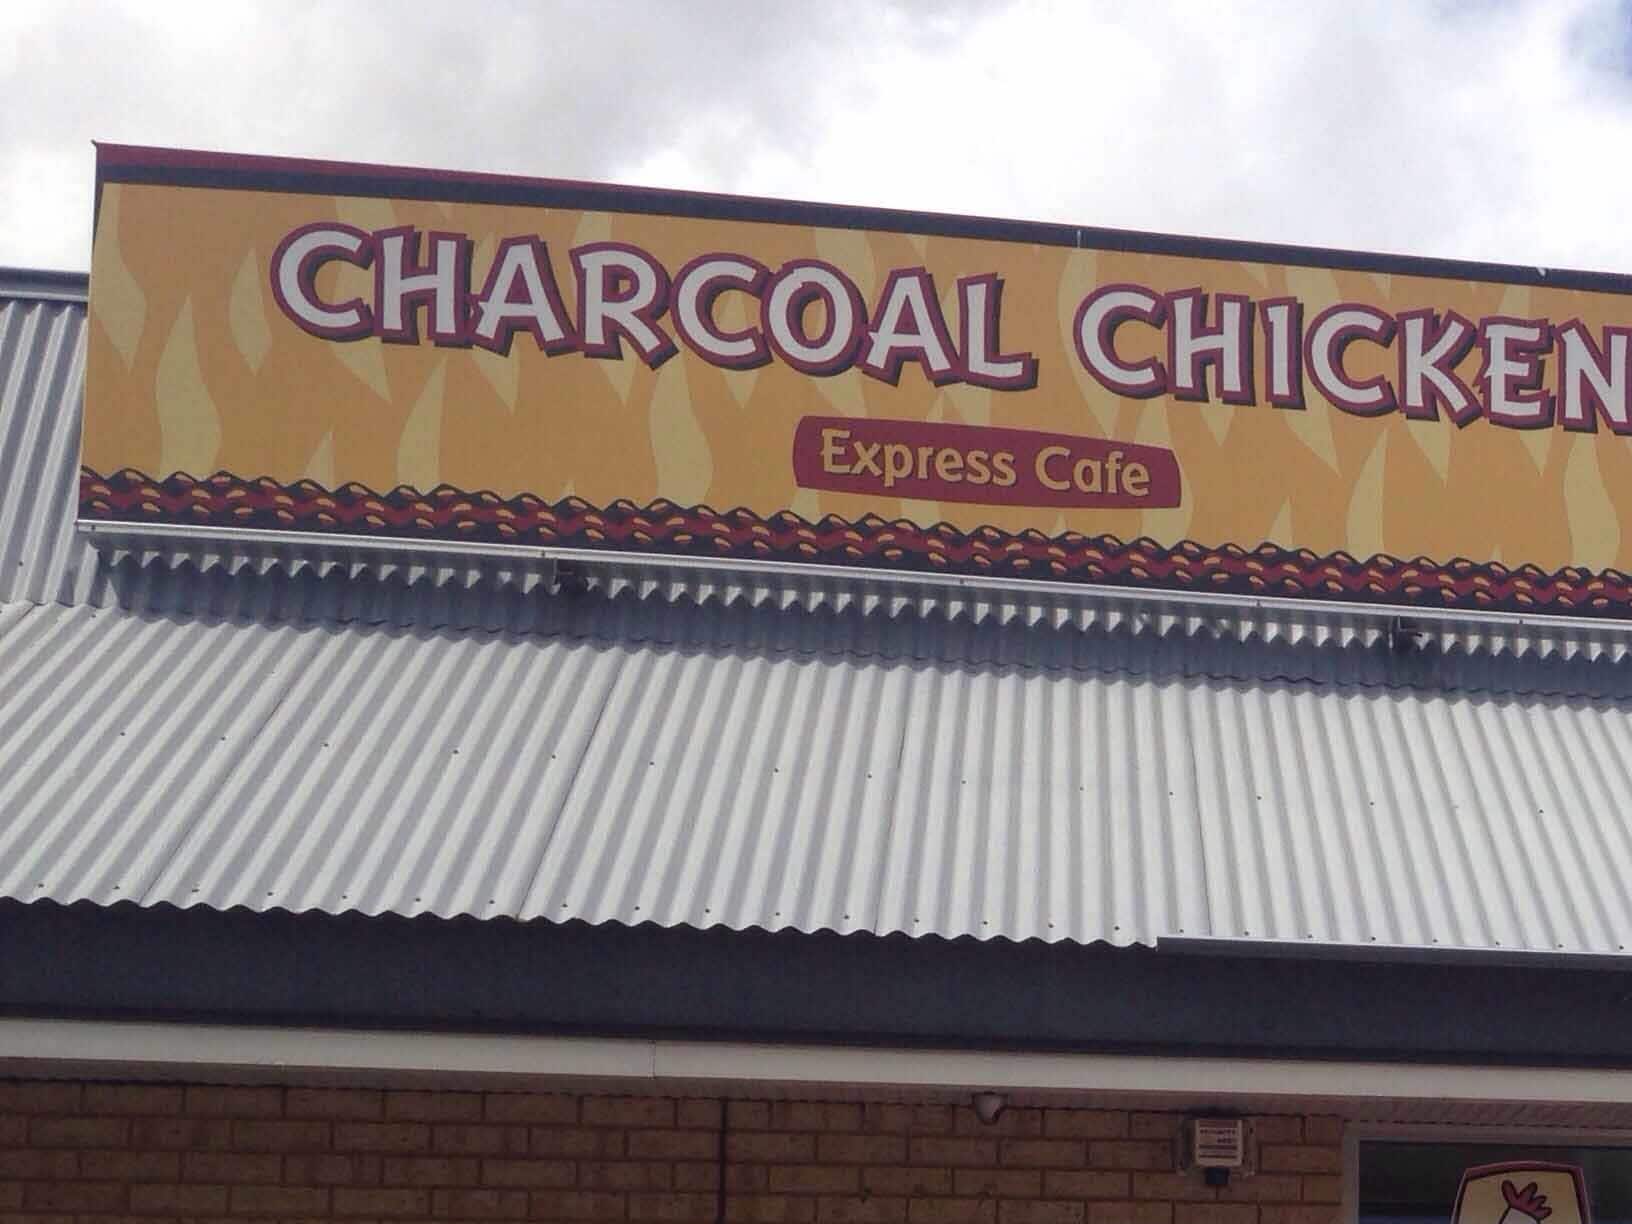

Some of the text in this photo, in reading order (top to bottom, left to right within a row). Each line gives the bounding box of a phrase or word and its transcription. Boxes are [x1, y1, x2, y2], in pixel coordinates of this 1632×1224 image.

[270, 221, 1038, 391] CHARCOAL
[820, 427, 1152, 498] Express Cafe
